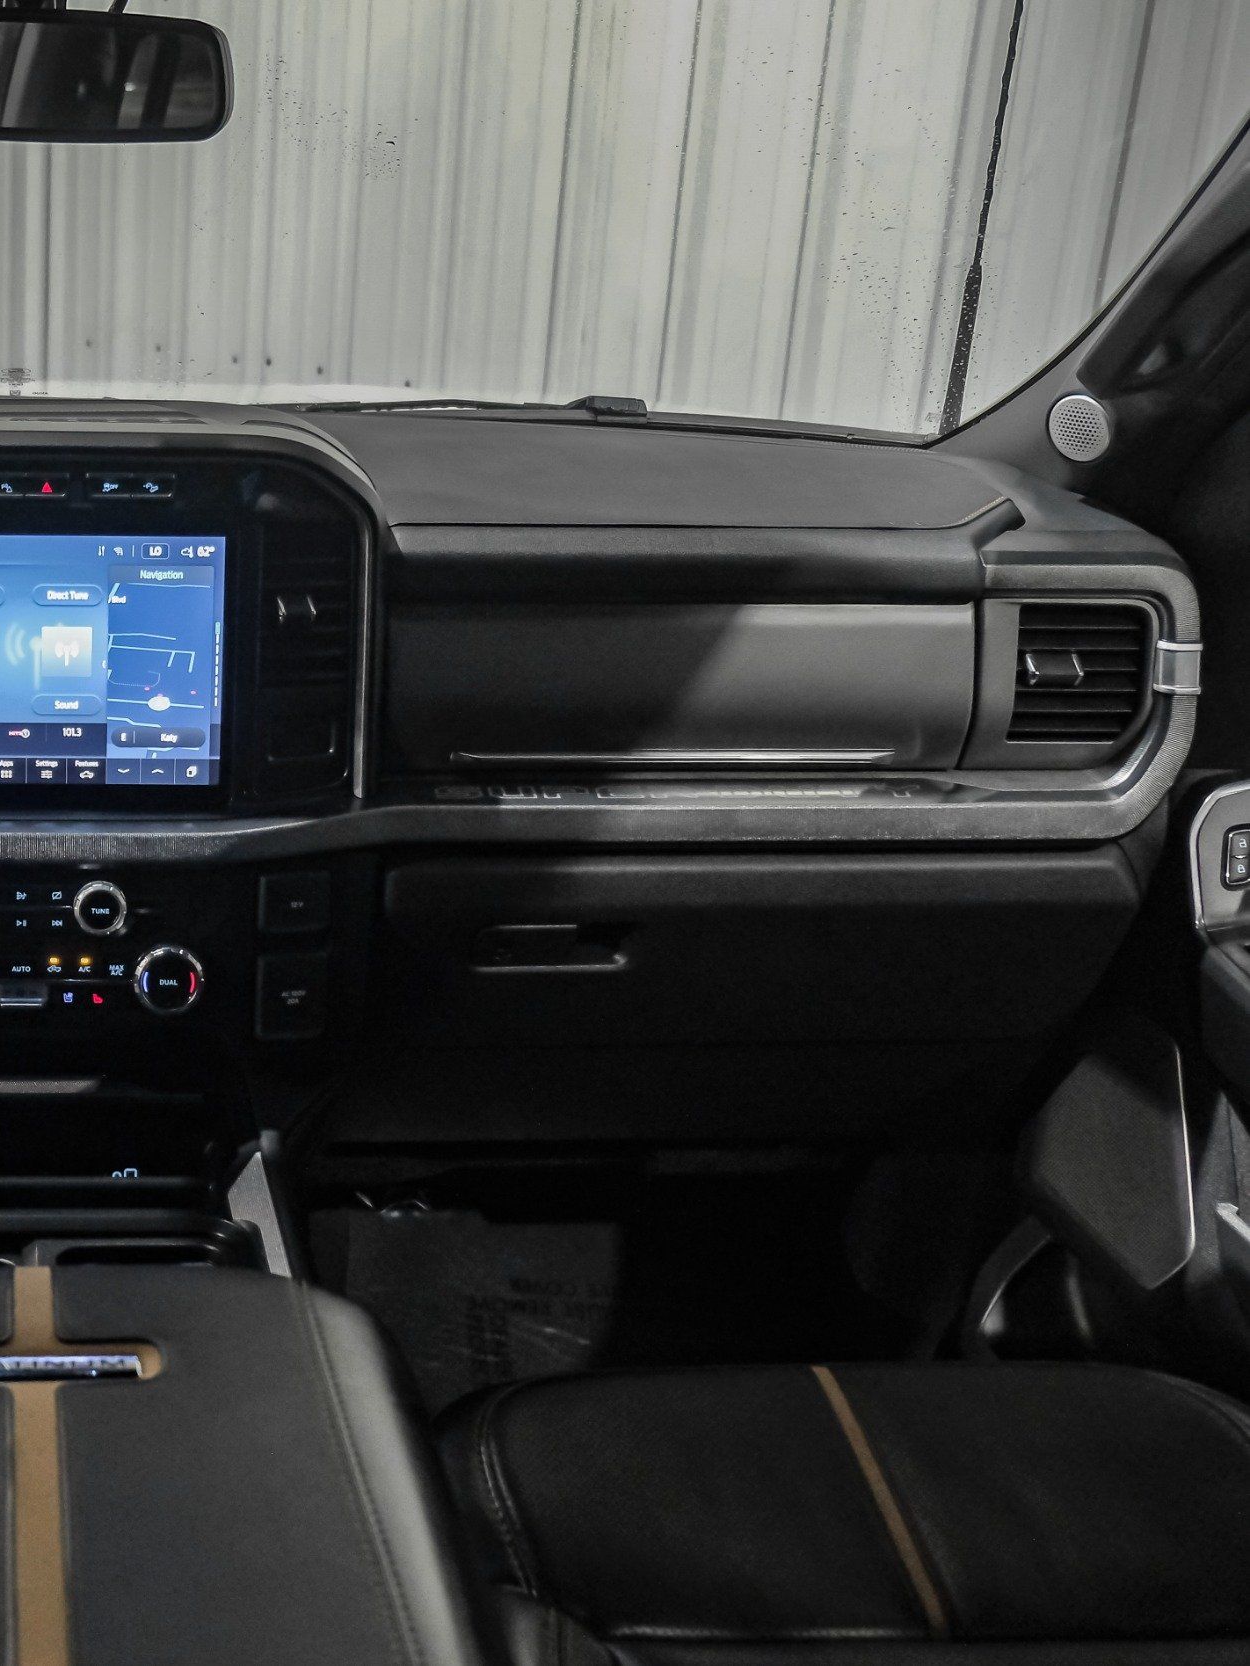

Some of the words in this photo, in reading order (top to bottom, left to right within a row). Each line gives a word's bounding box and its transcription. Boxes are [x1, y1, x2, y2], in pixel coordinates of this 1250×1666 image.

[139, 569, 184, 580] Navigation
[47, 590, 69, 600] Direct
[70, 590, 89, 600] Tune
[54, 700, 79, 710] Sound
[62, 727, 82, 737] 101.3
[35, 760, 58, 769] Settings
[91, 907, 110, 915] TUNE
[11, 965, 31, 973] AUTO
[78, 965, 91, 973] A/C
[159, 978, 179, 986] DUAL
